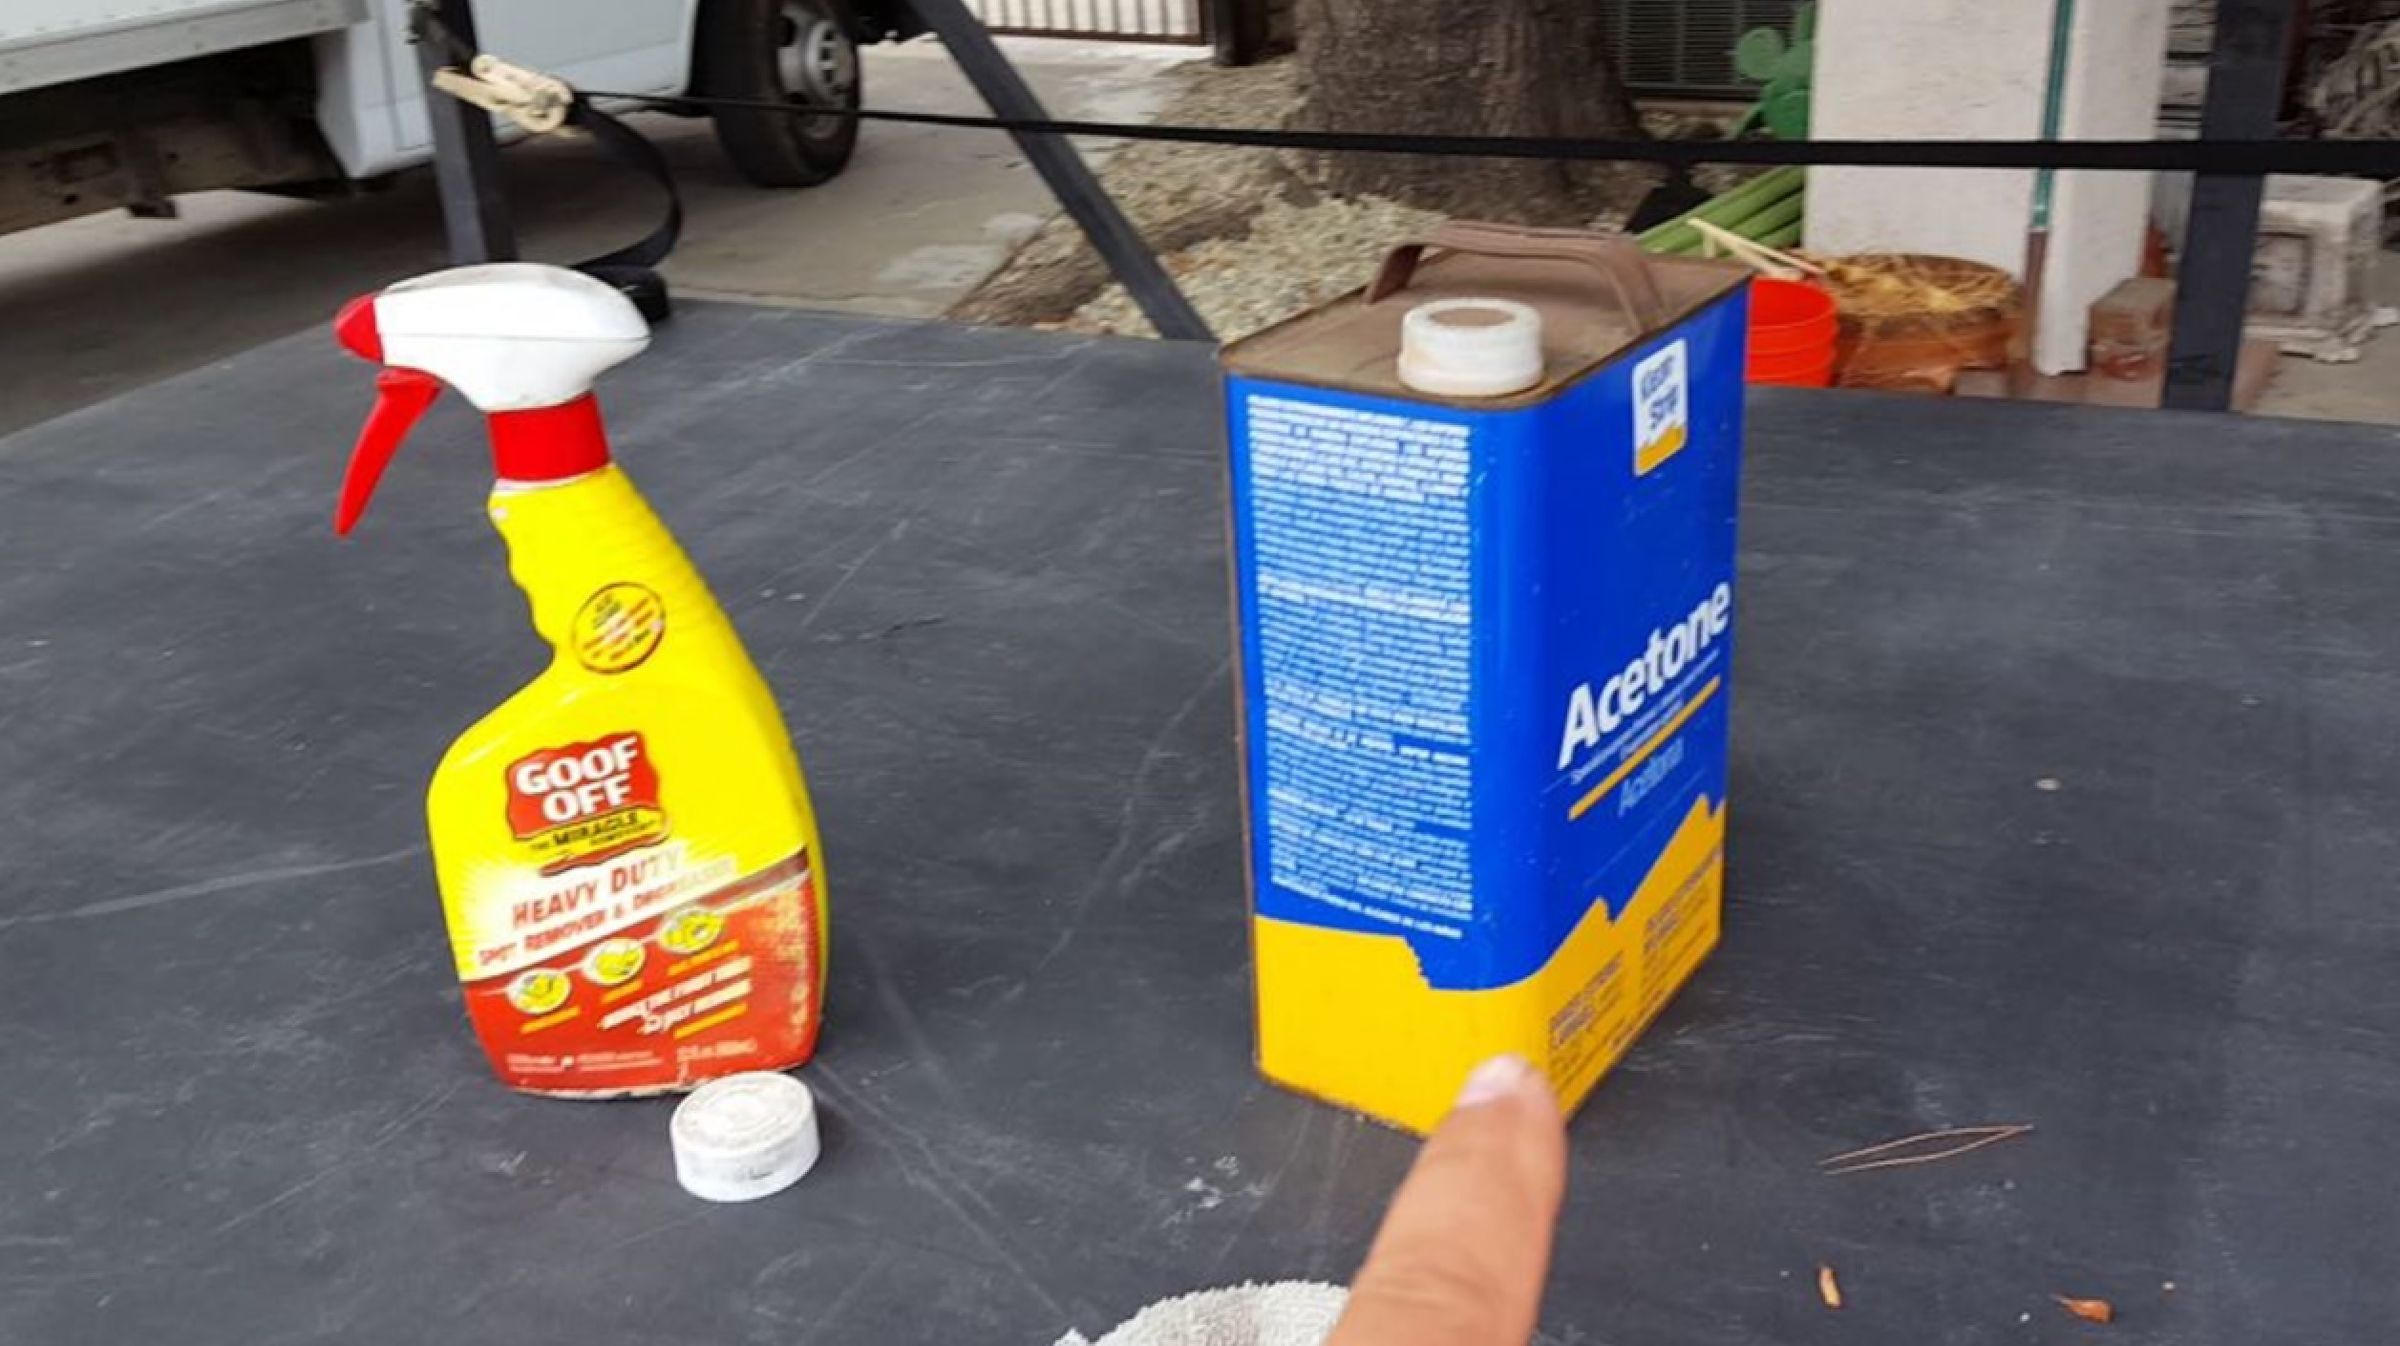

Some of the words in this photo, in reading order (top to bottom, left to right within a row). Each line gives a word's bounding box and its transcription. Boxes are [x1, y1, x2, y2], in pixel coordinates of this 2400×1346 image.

[1557, 581, 1731, 771] Acetone
[515, 735, 638, 796] GOOF
[541, 772, 632, 823] OFF
[512, 879, 598, 929] HEAVY
[610, 847, 682, 893] DUTY
